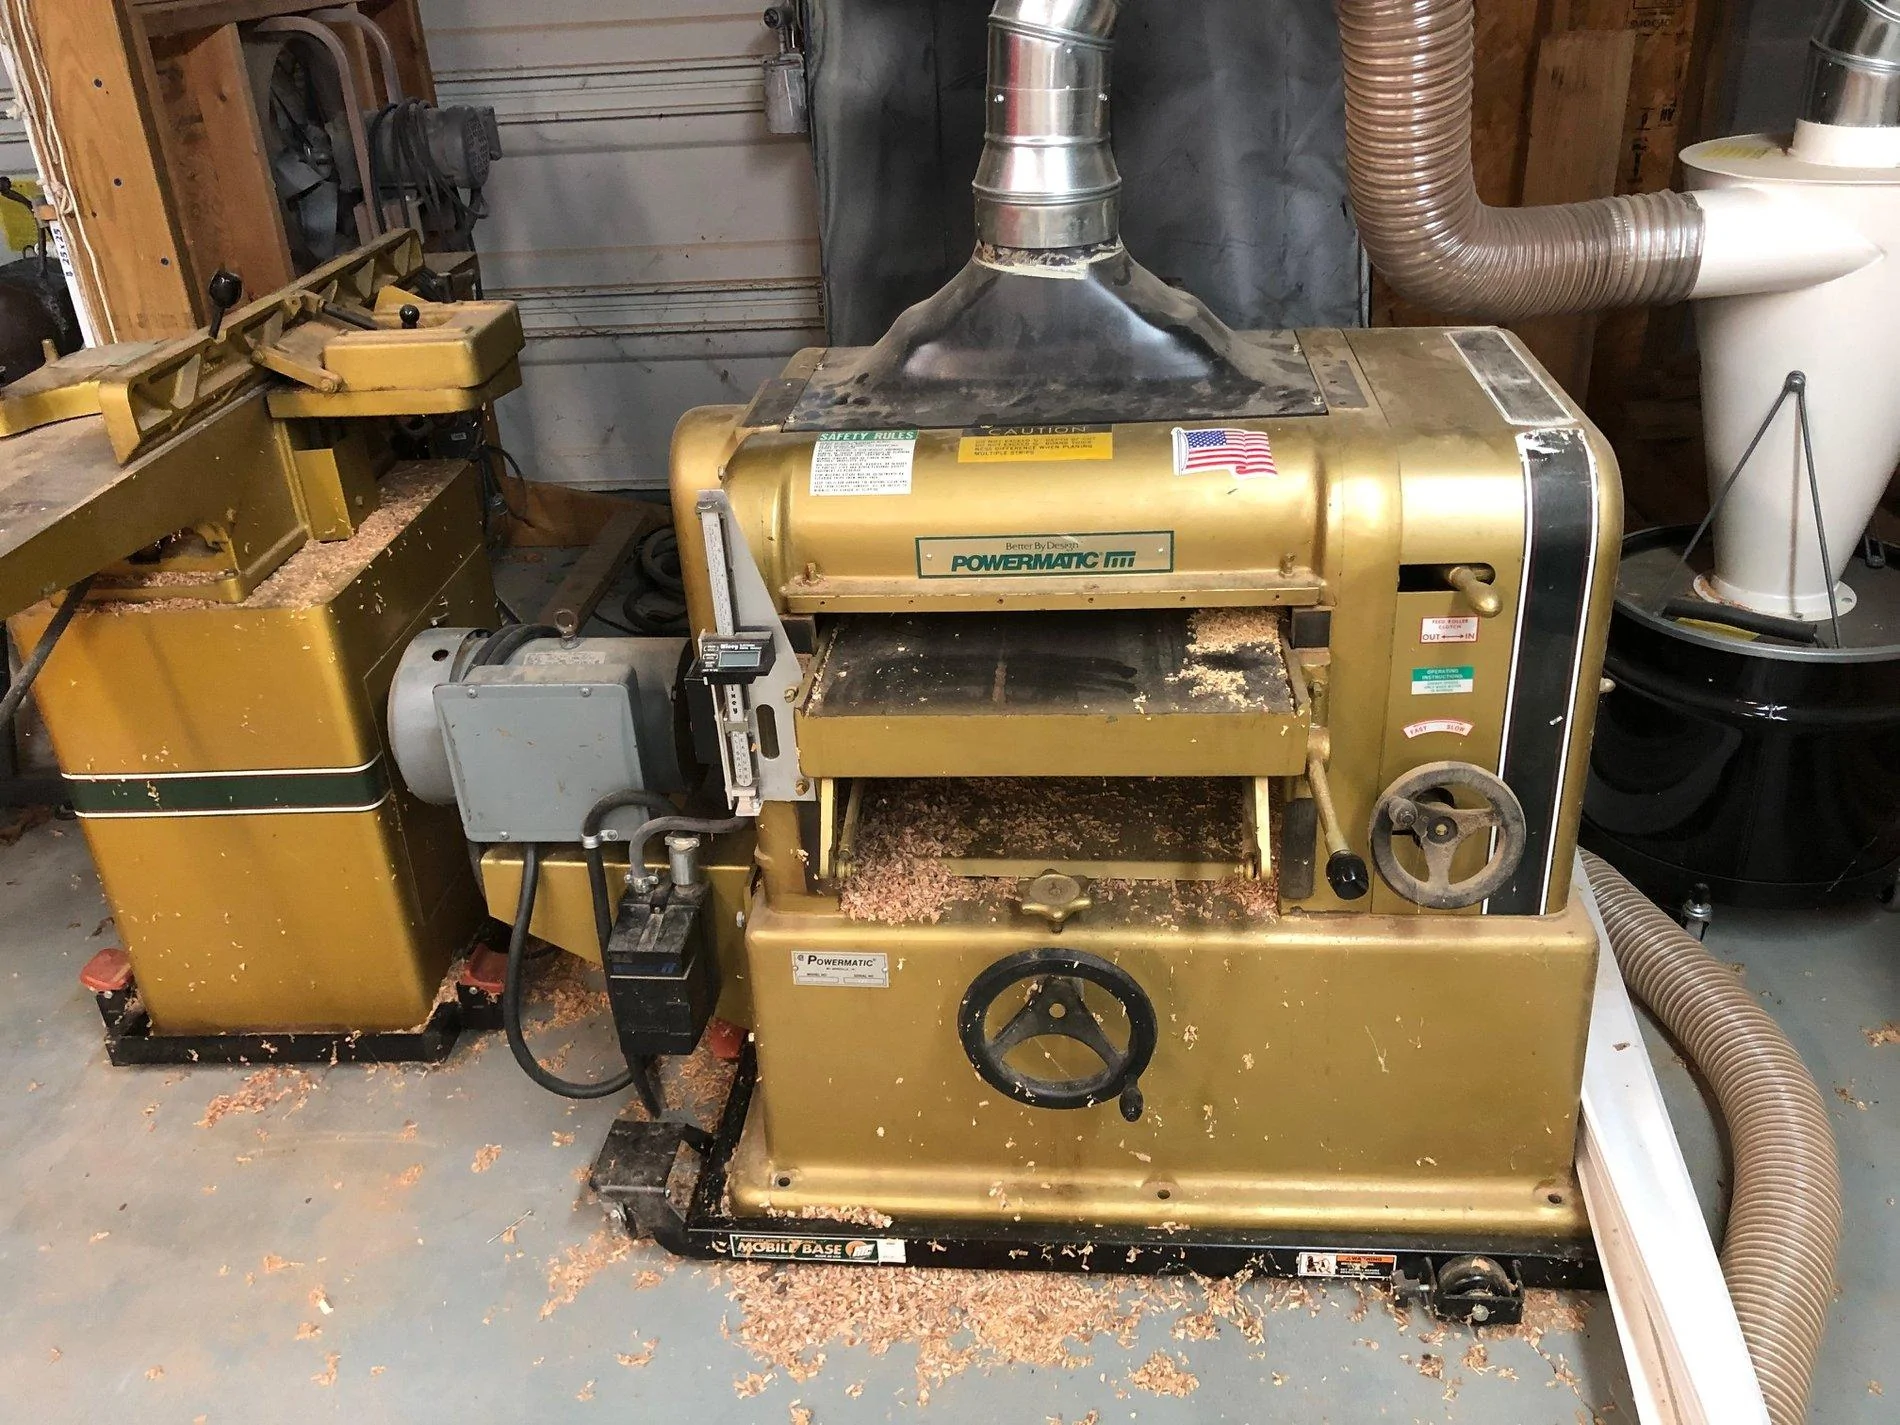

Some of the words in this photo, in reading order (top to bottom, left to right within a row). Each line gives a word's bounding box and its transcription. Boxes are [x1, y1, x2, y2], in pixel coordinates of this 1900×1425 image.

[820, 431, 869, 441] SAFETY
[874, 430, 914, 440] RULES
[988, 426, 1086, 436] CAUTION
[1006, 541, 1033, 551] Better
[1034, 541, 1046, 551] By
[1046, 540, 1079, 552] Design
[951, 551, 1099, 572] POWERMATIC
[1422, 633, 1441, 641] OUT
[1465, 632, 1475, 640] IN
[730, 685, 738, 714] ixey
[1409, 725, 1428, 735] FAST
[1446, 724, 1465, 732] SLOW
[802, 1243, 842, 1255] BASE
